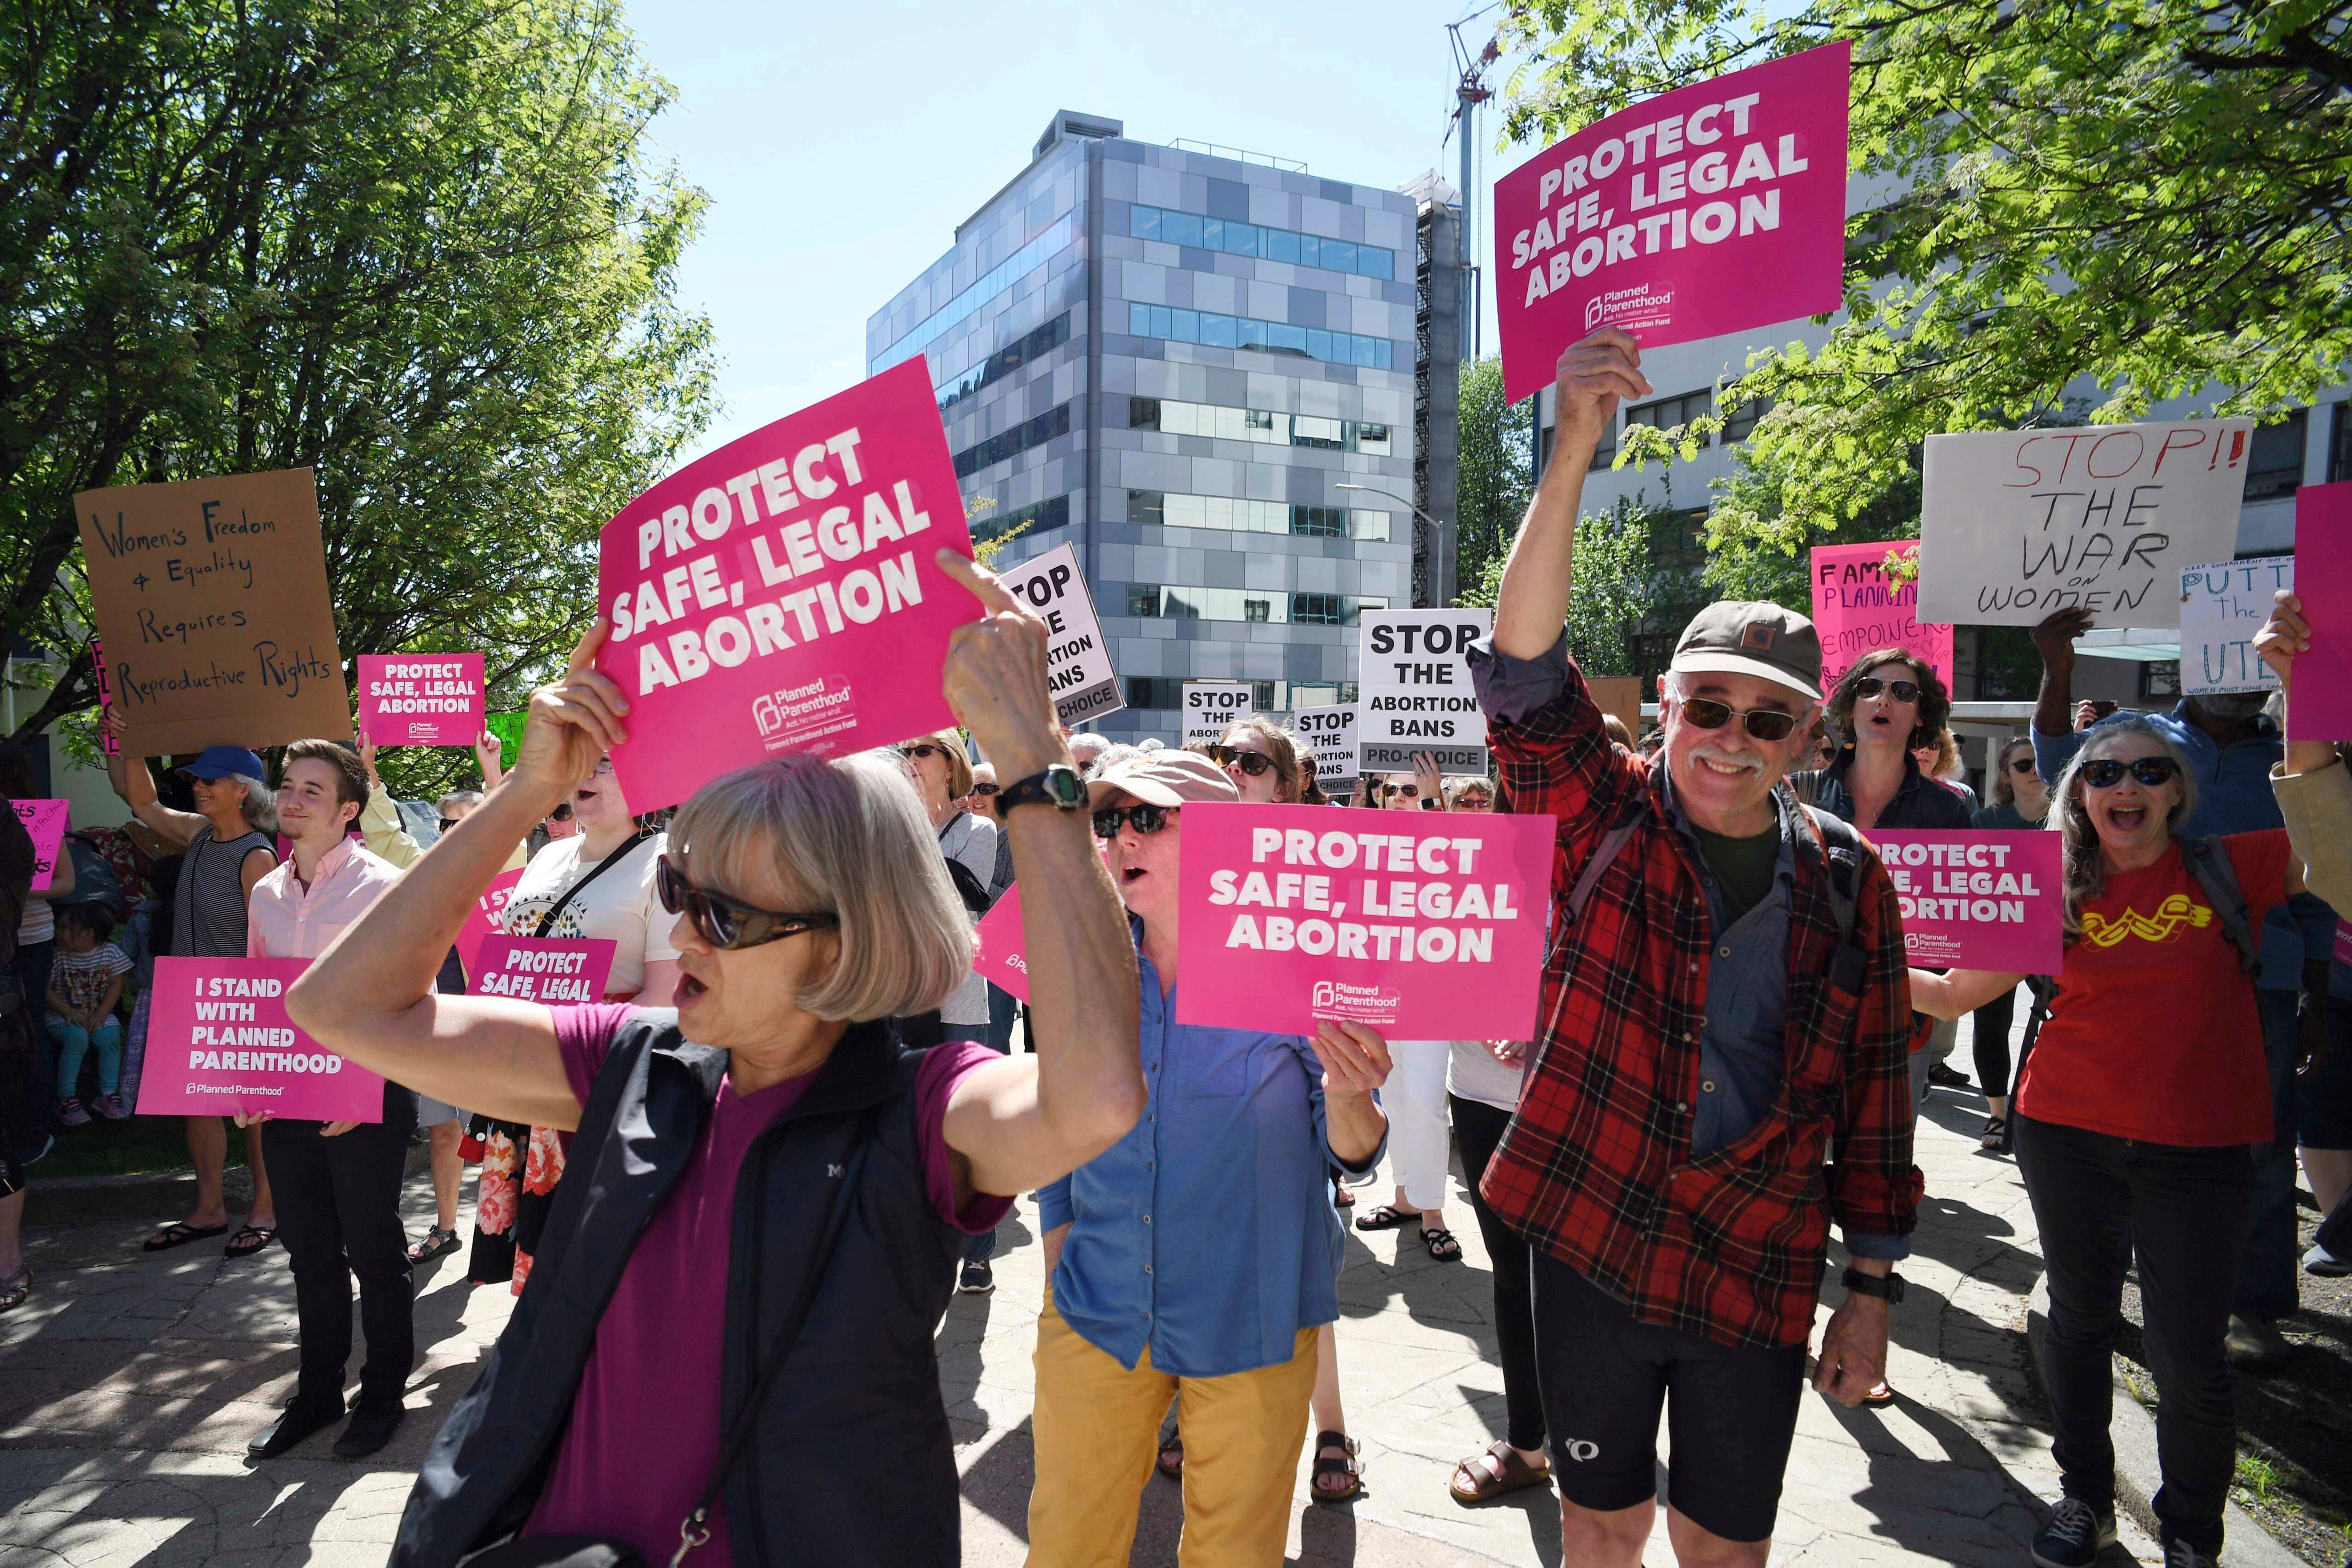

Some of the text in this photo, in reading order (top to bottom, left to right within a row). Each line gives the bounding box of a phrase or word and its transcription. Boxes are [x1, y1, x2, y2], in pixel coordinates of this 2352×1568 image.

[1539, 92, 1760, 211] PROTECT
[1512, 133, 1808, 270] SAFE, LEGAL
[1524, 188, 1781, 309] ABORTION
[1604, 283, 1649, 304] Planned
[1604, 292, 1670, 315] Parenthood
[1634, 321, 1654, 329] Action
[1656, 318, 1670, 326] Fund
[638, 427, 863, 570] PROTECT
[2031, 484, 2164, 531] THE
[92, 501, 276, 558] Women's Freedom
[167, 548, 253, 588] Equality
[610, 480, 931, 643] SAFE, LEGAL
[2023, 533, 2169, 579] WAR
[2211, 559, 2262, 568] GOVERNMENT
[1820, 561, 1894, 585] FAM
[2069, 574, 2098, 588] ON
[1824, 585, 1917, 609] PLANNIN
[1978, 578, 2154, 613] WOMEN
[138, 608, 247, 643] Requires
[638, 551, 923, 696] ABORTION
[1047, 634, 1093, 667] RTION
[1370, 625, 1480, 654] STOP
[117, 661, 245, 707] Reproductive
[253, 640, 330, 698] Rights
[385, 664, 462, 679] PROTECT
[1048, 665, 1085, 694] ANS
[1394, 663, 1453, 684] THE
[370, 681, 476, 698] SAFE, LEGAL
[775, 678, 825, 705] Planned
[1189, 692, 1249, 708] STOP
[378, 698, 469, 713] ABORTION
[780, 687, 850, 719] Parenthood
[1058, 687, 1113, 719] CHOICE
[1370, 696, 1477, 712] ABORTION
[1202, 712, 1235, 723] THE
[1300, 712, 1354, 731] STOP
[1391, 719, 1455, 737] BANS
[765, 739, 789, 752] Planned
[789, 729, 823, 745] Parenthood
[824, 725, 842, 735] Action
[843, 719, 857, 730] Fund
[1311, 734, 1341, 747] THE
[1314, 751, 1353, 761] ORTION
[1367, 749, 1478, 765] PRO-COICE
[1318, 764, 1342, 775] ANS
[1320, 781, 1355, 789] CHOICE
[1252, 827, 1483, 875] PROTECT
[1208, 870, 1518, 920] SAFE, LEGAL
[1933, 872, 2040, 896] LEGAL
[1898, 896, 2024, 923] ORTION
[1225, 914, 1494, 963] ABORTION
[1920, 940, 1960, 948] Parenthood
[505, 949, 587, 974] PROTECT
[196, 978, 282, 997] I STAND
[479, 971, 591, 1002] SAFE, LEGAL
[1336, 982, 1379, 996] Planned
[195, 1002, 255, 1021] WITH
[1335, 994, 1397, 1007] Parenthood
[191, 1026, 295, 1047] PLANNED
[197, 1084, 282, 1096] Planned Parenthood
